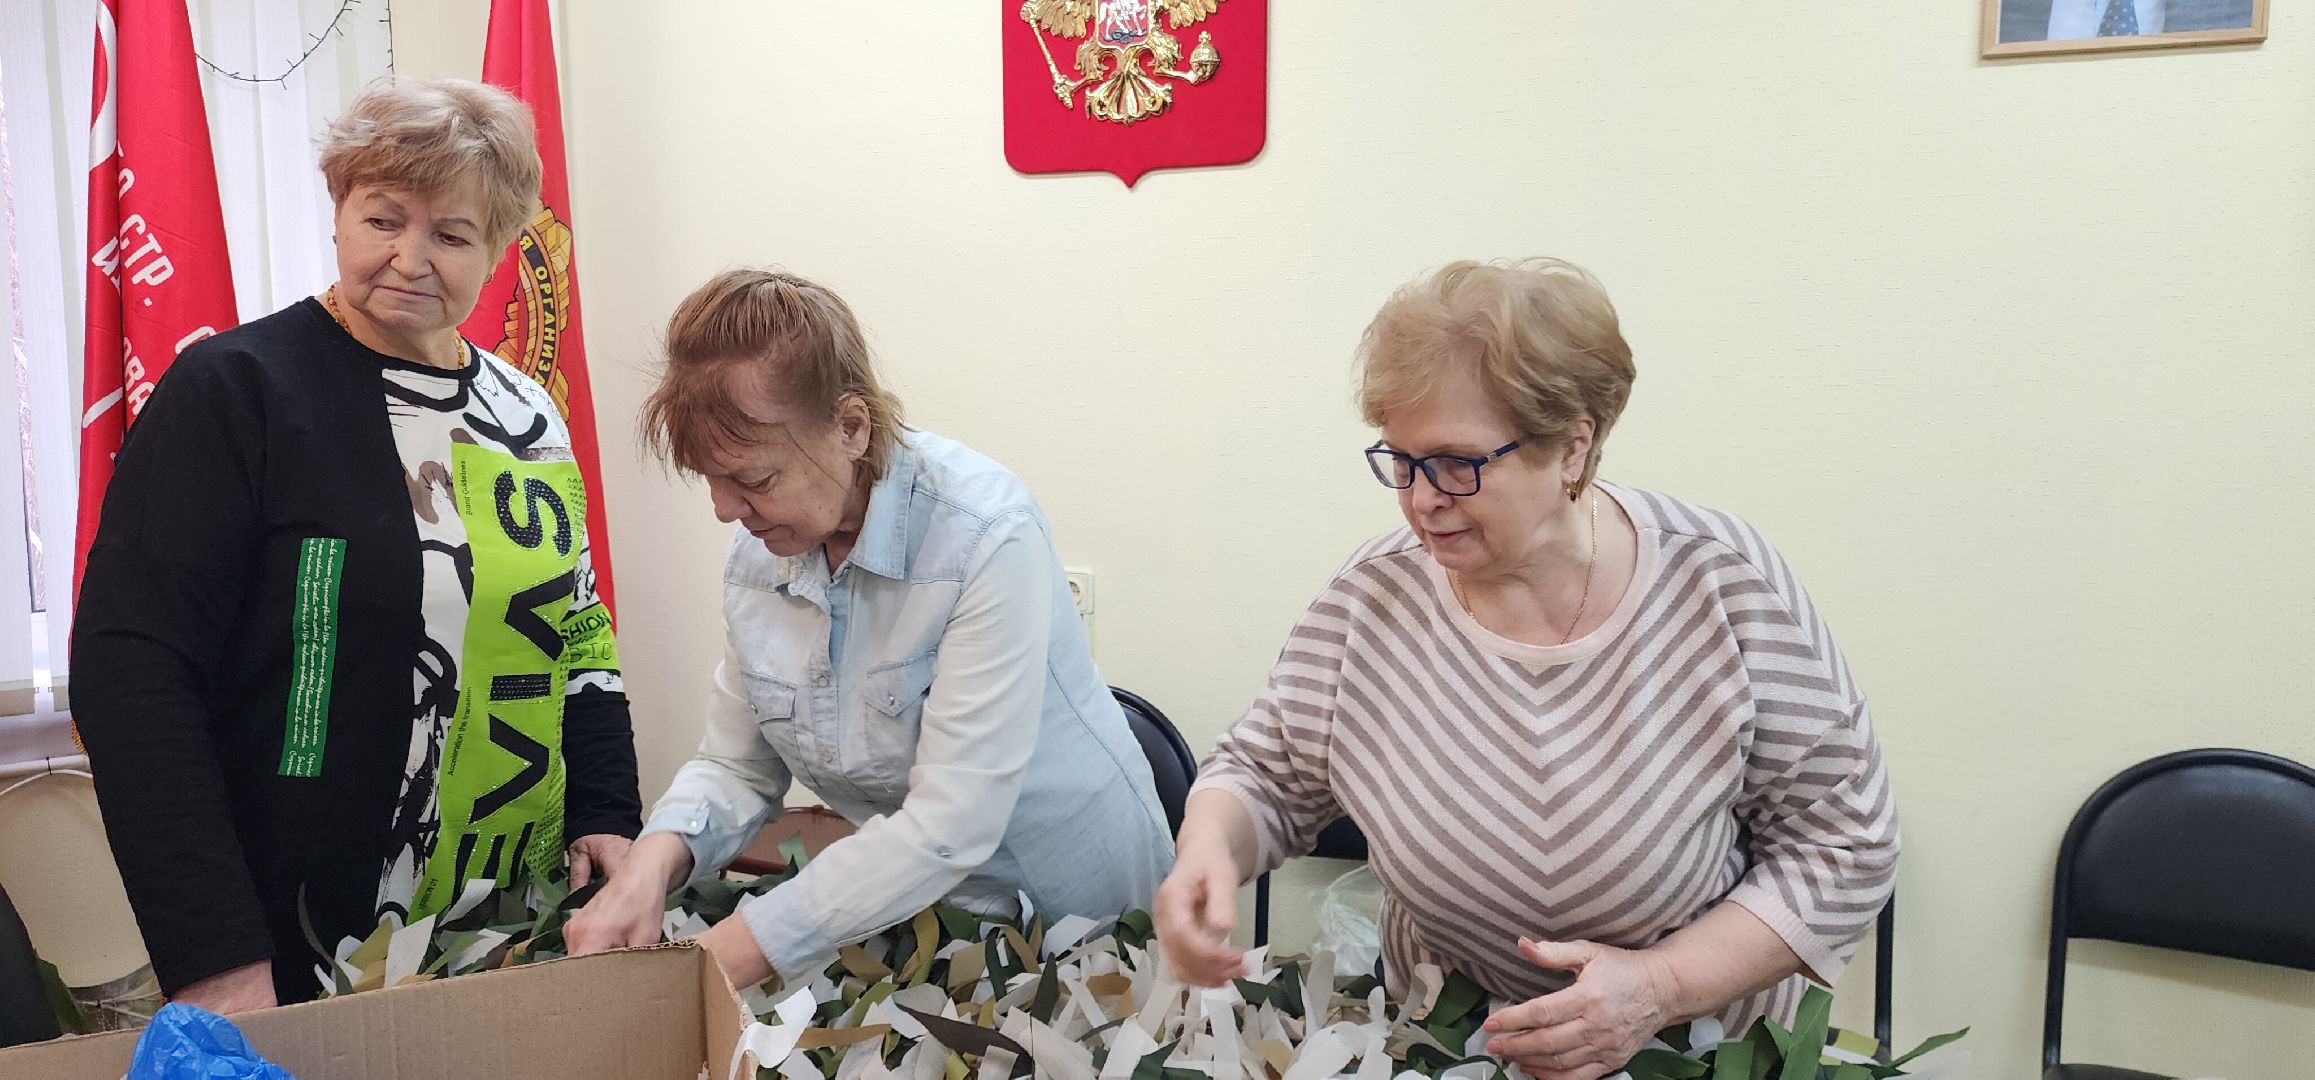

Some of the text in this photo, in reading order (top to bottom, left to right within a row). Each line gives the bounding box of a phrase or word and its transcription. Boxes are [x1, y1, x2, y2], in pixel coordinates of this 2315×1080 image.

[459, 460, 473, 516] Brand Guidelines
[447, 687, 472, 776] Acceleration the transition
[429, 878, 439, 887] 01
